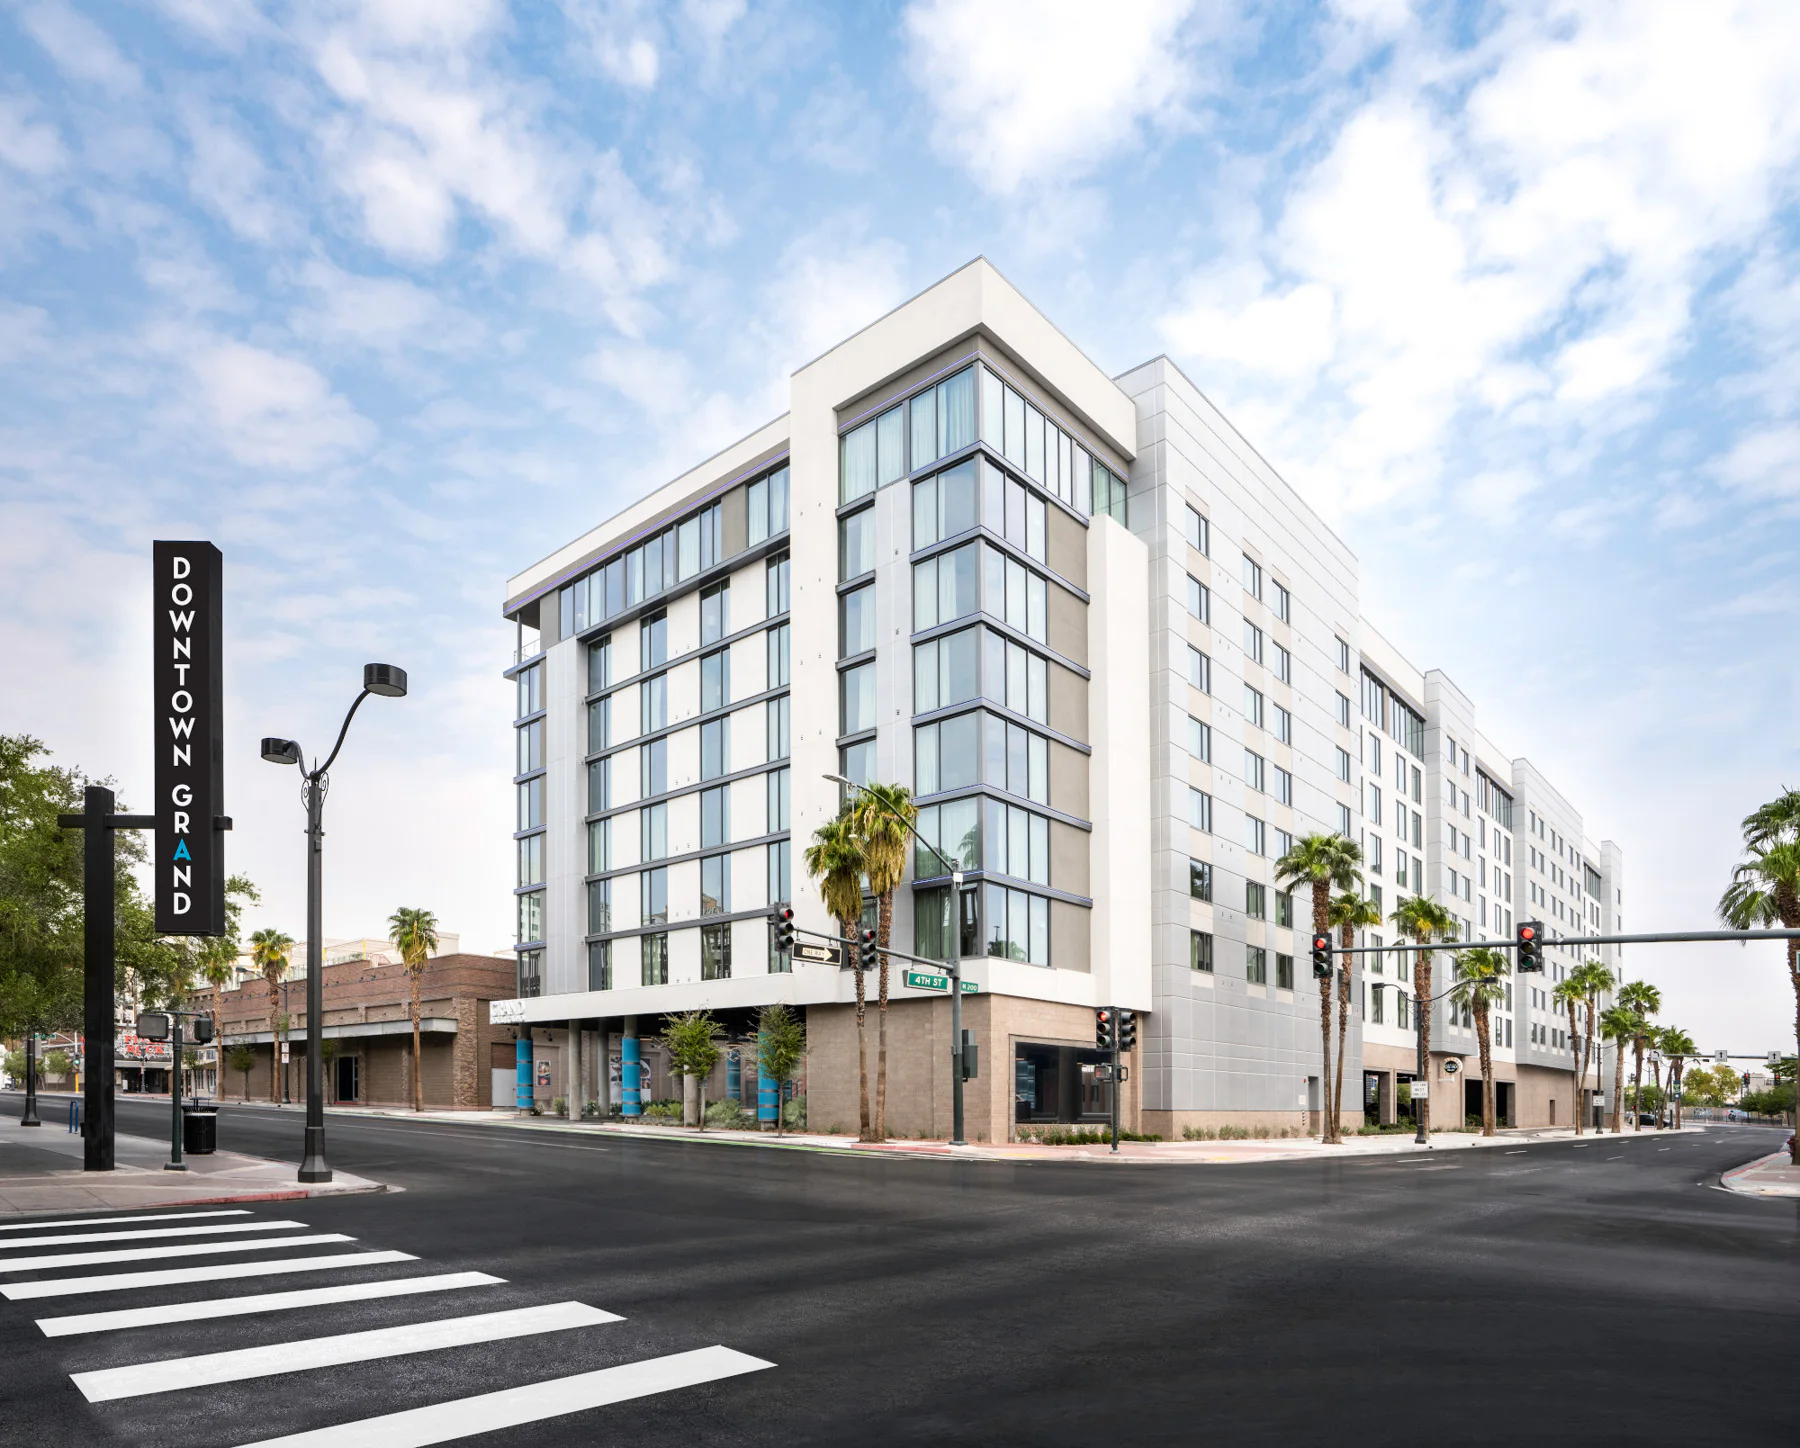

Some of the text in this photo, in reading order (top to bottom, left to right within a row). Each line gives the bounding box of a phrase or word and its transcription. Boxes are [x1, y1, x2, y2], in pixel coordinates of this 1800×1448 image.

[169, 556, 195, 915] DOWNTOWN GRAND
[915, 976, 943, 987] 4TH ST
[126, 1045, 165, 1056] ROCK
